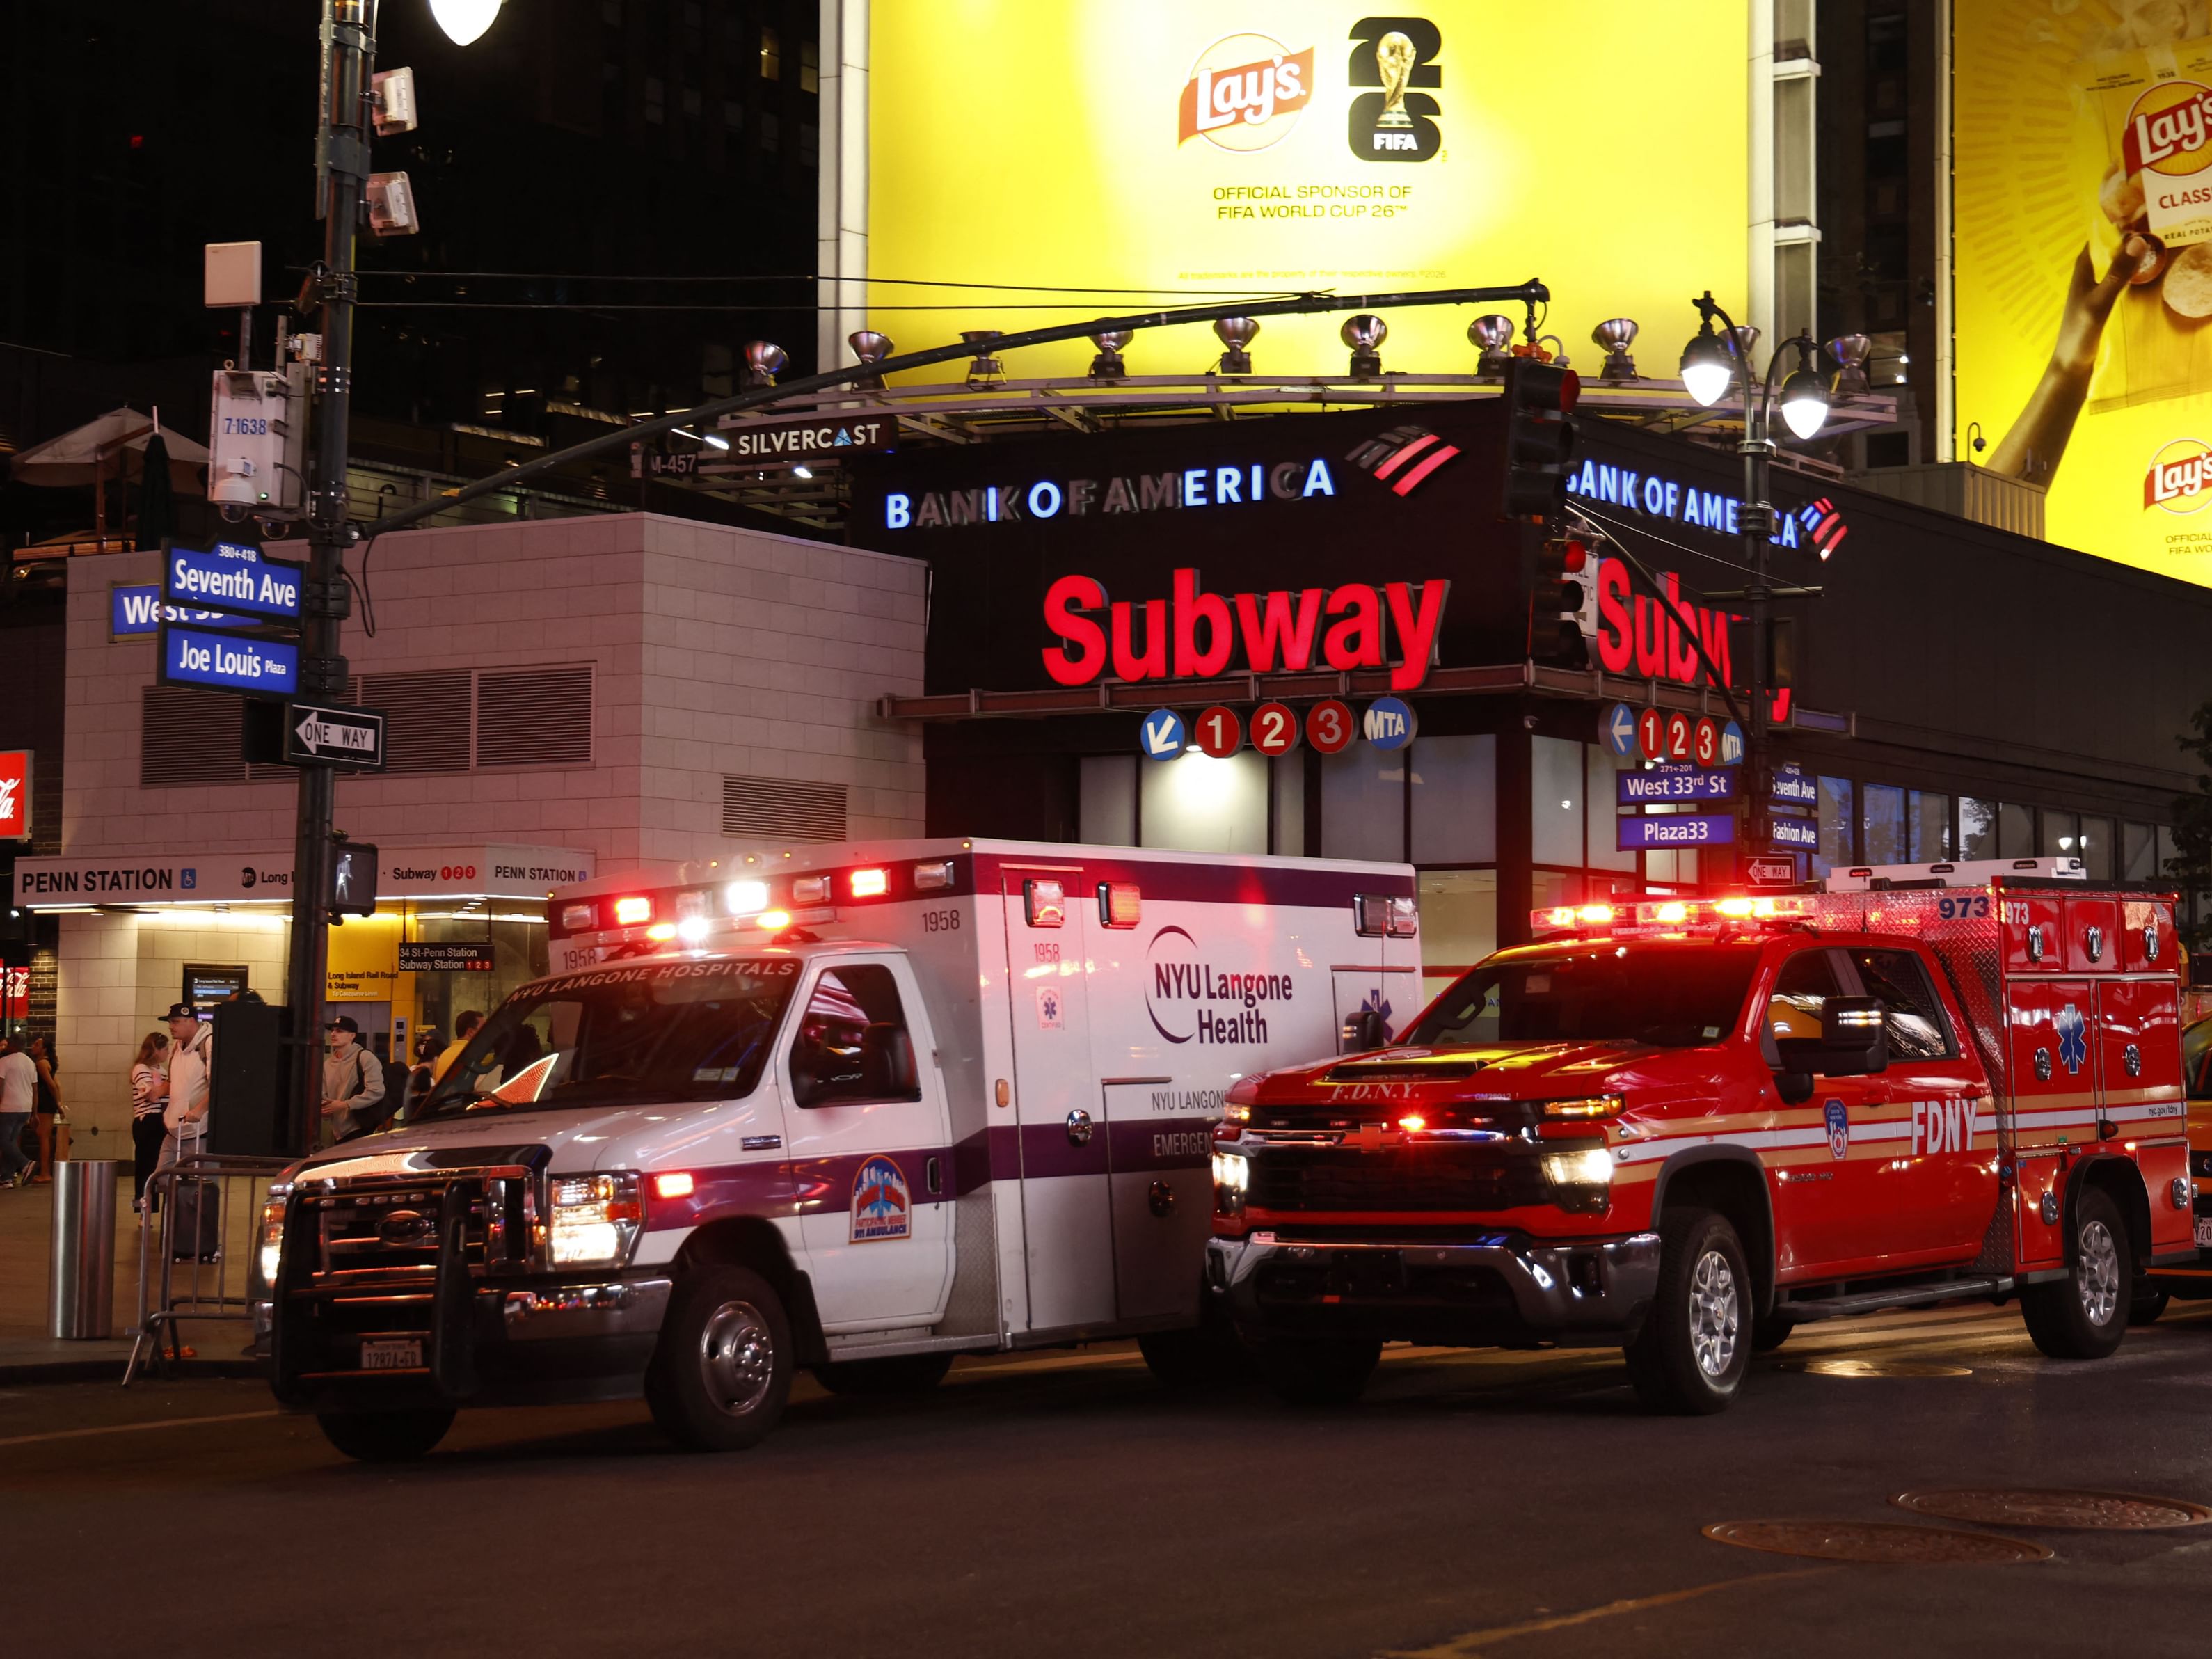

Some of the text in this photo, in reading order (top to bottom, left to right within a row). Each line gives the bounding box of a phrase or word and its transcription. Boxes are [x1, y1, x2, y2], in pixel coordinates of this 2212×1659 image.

[1373, 134, 1418, 150] FIFA
[1213, 185, 1412, 200] OFFICIAL SPONSOR OF
[1218, 206, 1254, 219] FIFA
[1259, 205, 1326, 219] WORLD
[1330, 204, 1367, 218] CUP
[2154, 451, 2212, 502] Lay's
[886, 459, 1335, 530] BANK OF AMERICA
[1644, 477, 1678, 517] OF
[1684, 488, 1799, 548] AMEA
[2169, 546, 2191, 555] FIFA
[175, 559, 296, 607] Seventh Ave
[1042, 567, 1450, 691] Subway
[180, 640, 286, 678] Joe Louis Plaza
[305, 722, 368, 749] ONE WAY
[1207, 717, 1225, 749] 1
[1262, 711, 1285, 747] 2
[1317, 708, 1342, 743] 3
[1646, 717, 1655, 750] 1
[1673, 721, 1686, 754] 2
[1699, 726, 1712, 759] 3
[1627, 774, 1726, 796] West 33rd St
[1801, 781, 1815, 800] Ave
[1644, 821, 1708, 841] Plaza33
[1772, 822, 1815, 844] Fashion Ave
[22, 868, 173, 894] PENN STATION
[261, 871, 288, 885] Long
[393, 867, 437, 882] Subway
[495, 866, 575, 882] PENN STATION
[1753, 866, 1787, 878] ONE WAY
[1939, 896, 1989, 919] 973
[2005, 901, 2030, 925] 973
[921, 910, 960, 932] 1958
[399, 947, 477, 958] 34 St-Penn Station
[563, 948, 596, 970] 1958
[1034, 944, 1060, 962] 1958
[328, 972, 344, 981] Long
[366, 971, 379, 980] Rail
[381, 971, 399, 980] Road
[399, 960, 431, 971] Subway
[433, 960, 464, 969] Station
[334, 982, 360, 991] Subway
[509, 962, 795, 1003] NYU LANGONE HOSPITALS
[1154, 963, 1293, 1007] NYU Langone
[1198, 1008, 1268, 1045] Health
[1152, 1089, 1227, 1111] NYU LANGON
[1331, 1083, 1419, 1100] F.D.N.Y.
[1911, 1099, 1977, 1155] FDNY
[1153, 1132, 1212, 1157] EMERGEN
